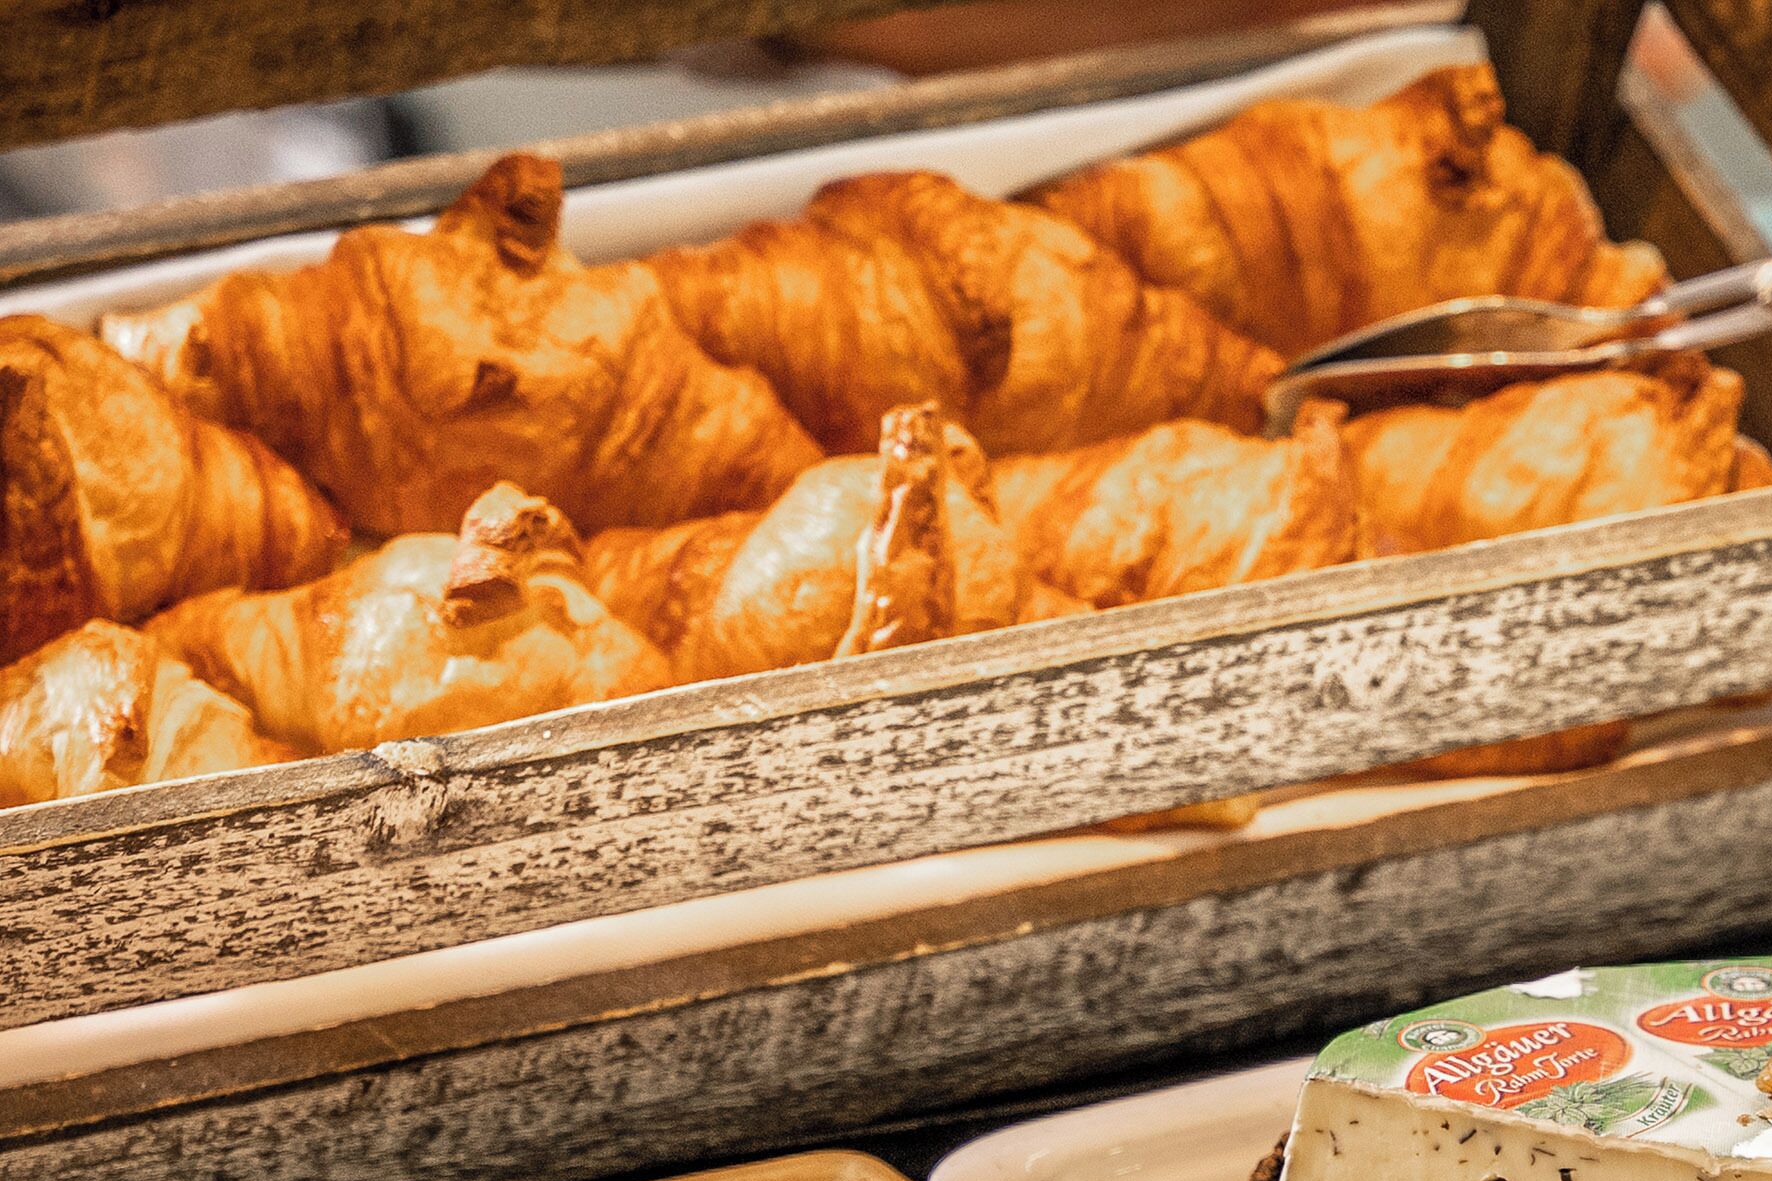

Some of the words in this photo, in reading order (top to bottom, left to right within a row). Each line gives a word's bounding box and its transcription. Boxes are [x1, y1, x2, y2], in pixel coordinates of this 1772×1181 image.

[1422, 1021, 1576, 1096] Allgäuer
[1474, 1066, 1550, 1107] Rahm
[1544, 1045, 1599, 1081] Torte
[1637, 1081, 1684, 1129] Kräuter
